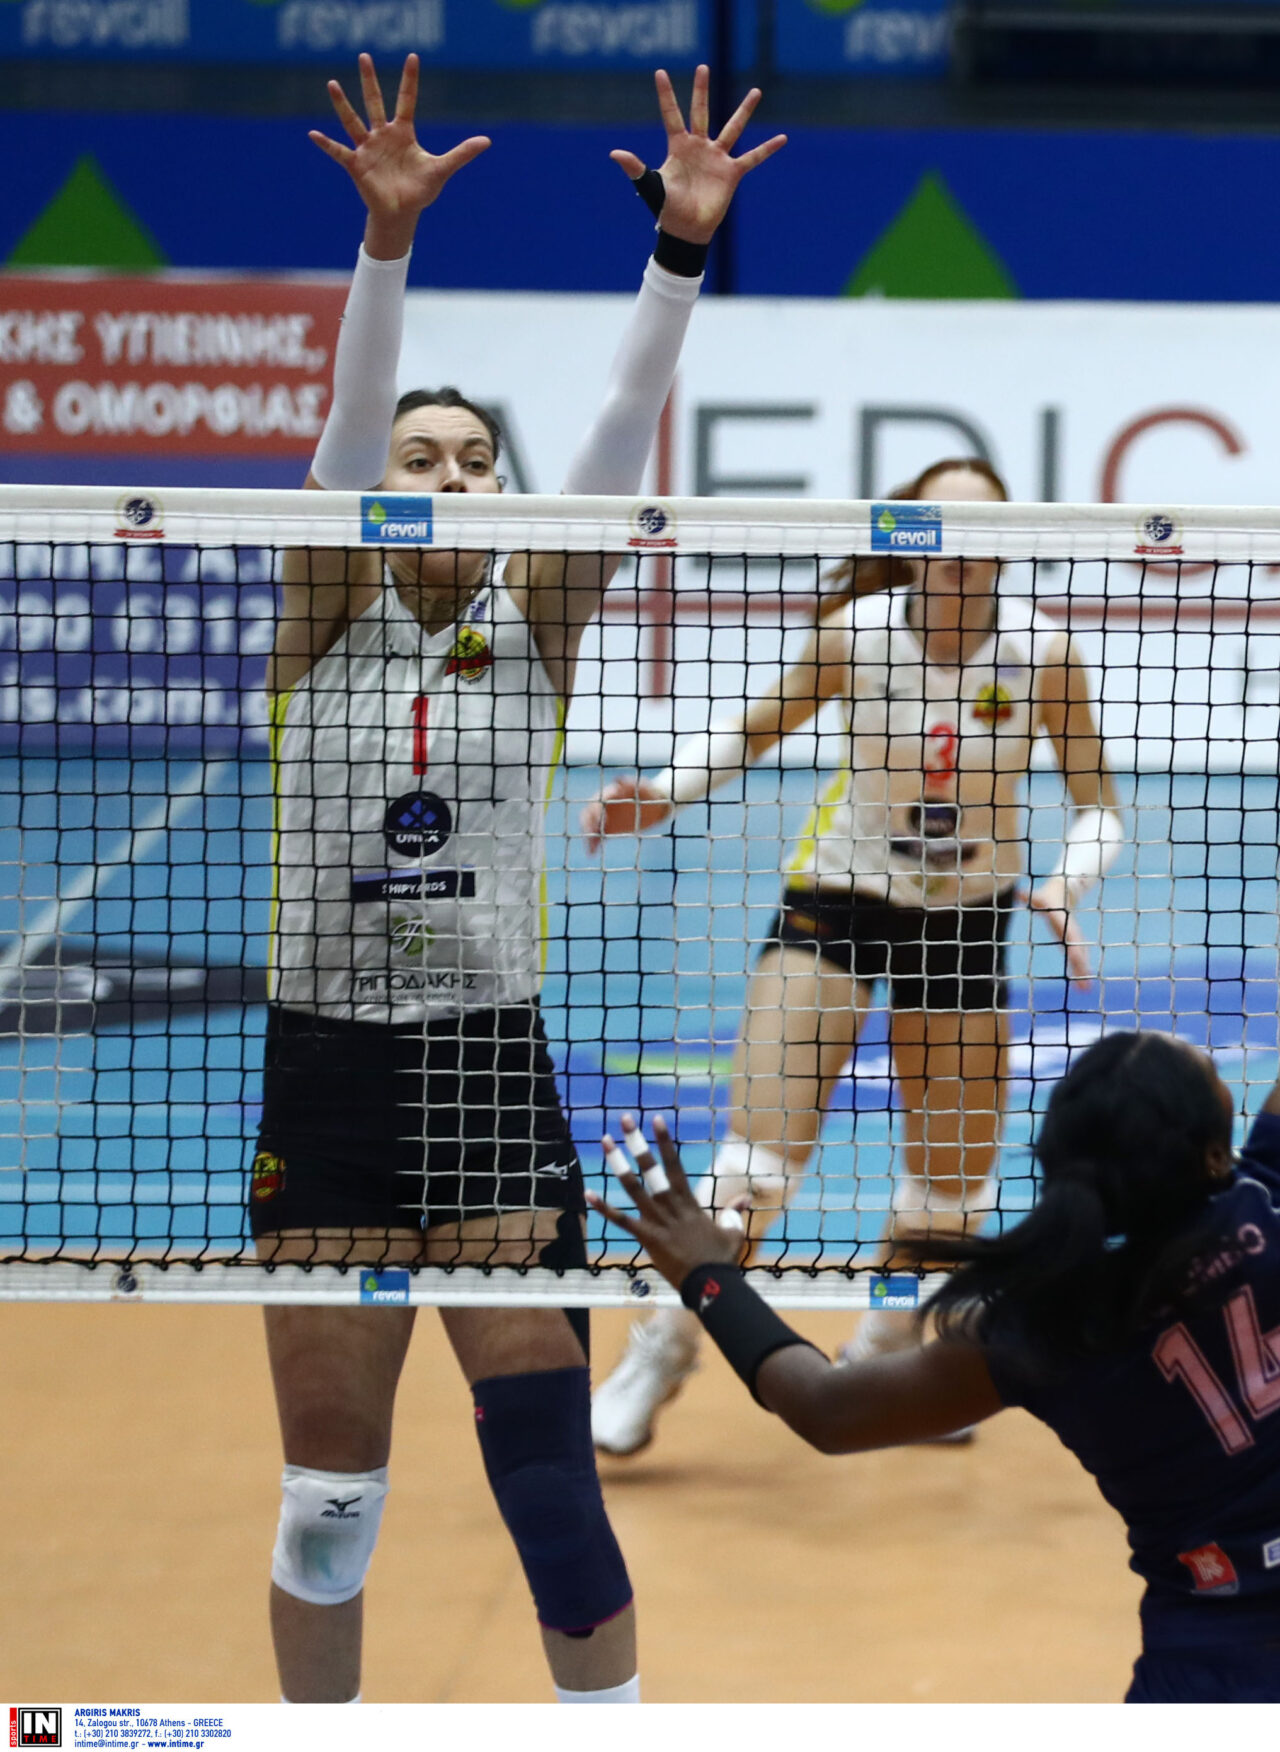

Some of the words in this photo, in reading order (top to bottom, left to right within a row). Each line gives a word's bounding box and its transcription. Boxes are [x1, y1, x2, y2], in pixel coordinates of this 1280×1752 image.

[380, 521, 427, 538] revoil
[890, 529, 937, 546] revoil
[411, 695, 429, 776] 1
[923, 721, 956, 785] 3
[882, 1293, 916, 1306] revoil
